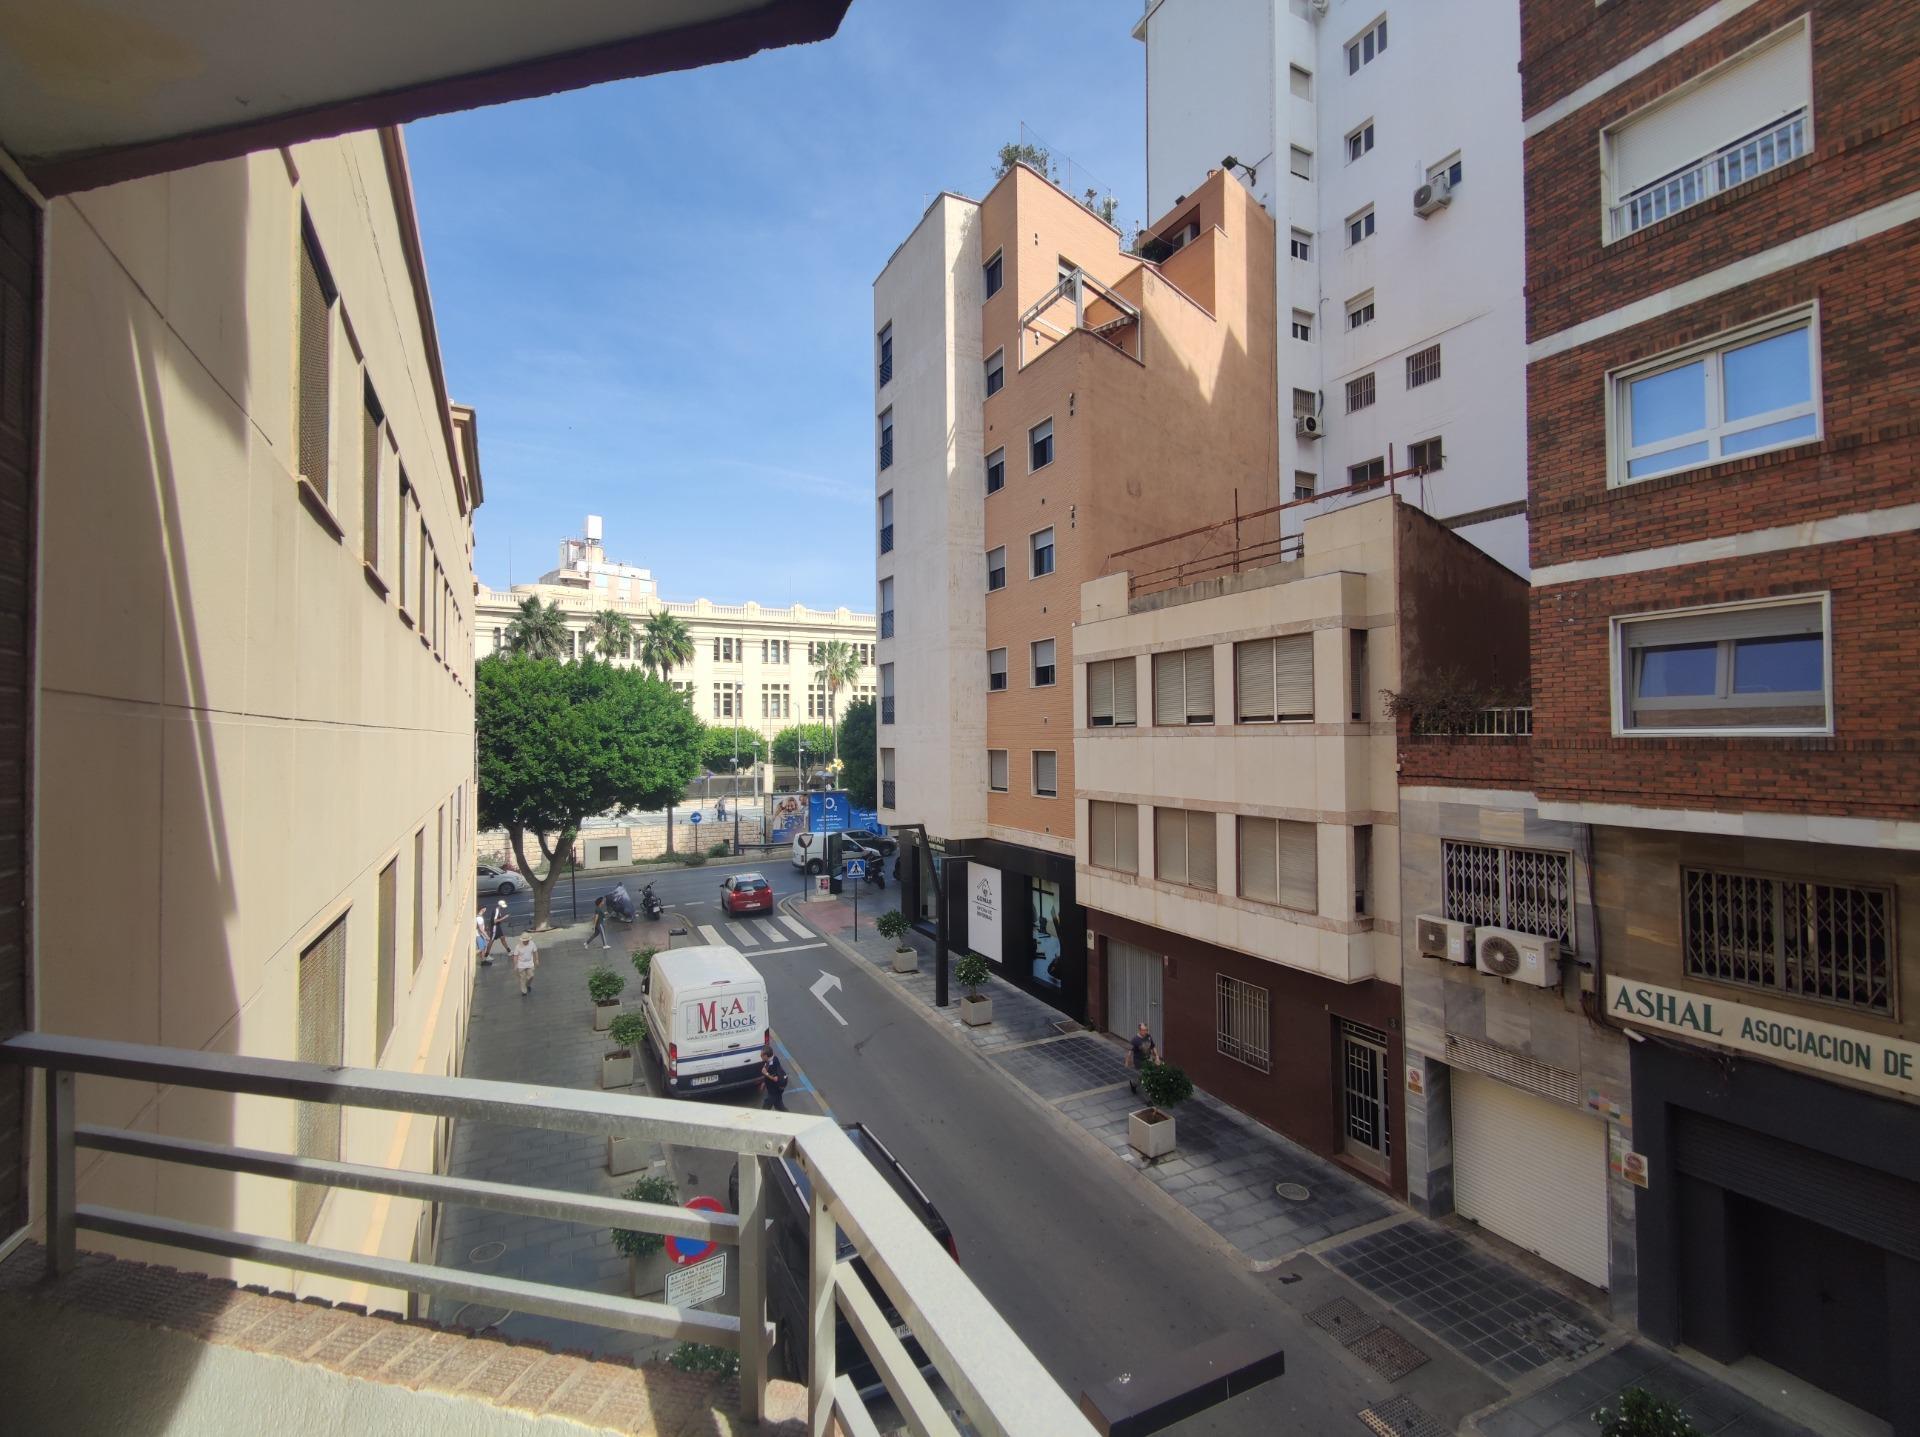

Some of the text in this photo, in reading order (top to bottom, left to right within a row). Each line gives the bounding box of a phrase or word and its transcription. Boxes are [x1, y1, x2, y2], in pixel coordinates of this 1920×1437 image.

[721, 1014, 756, 1030] block
[1613, 985, 1913, 1081] ASHAL ASOCIACION DE
